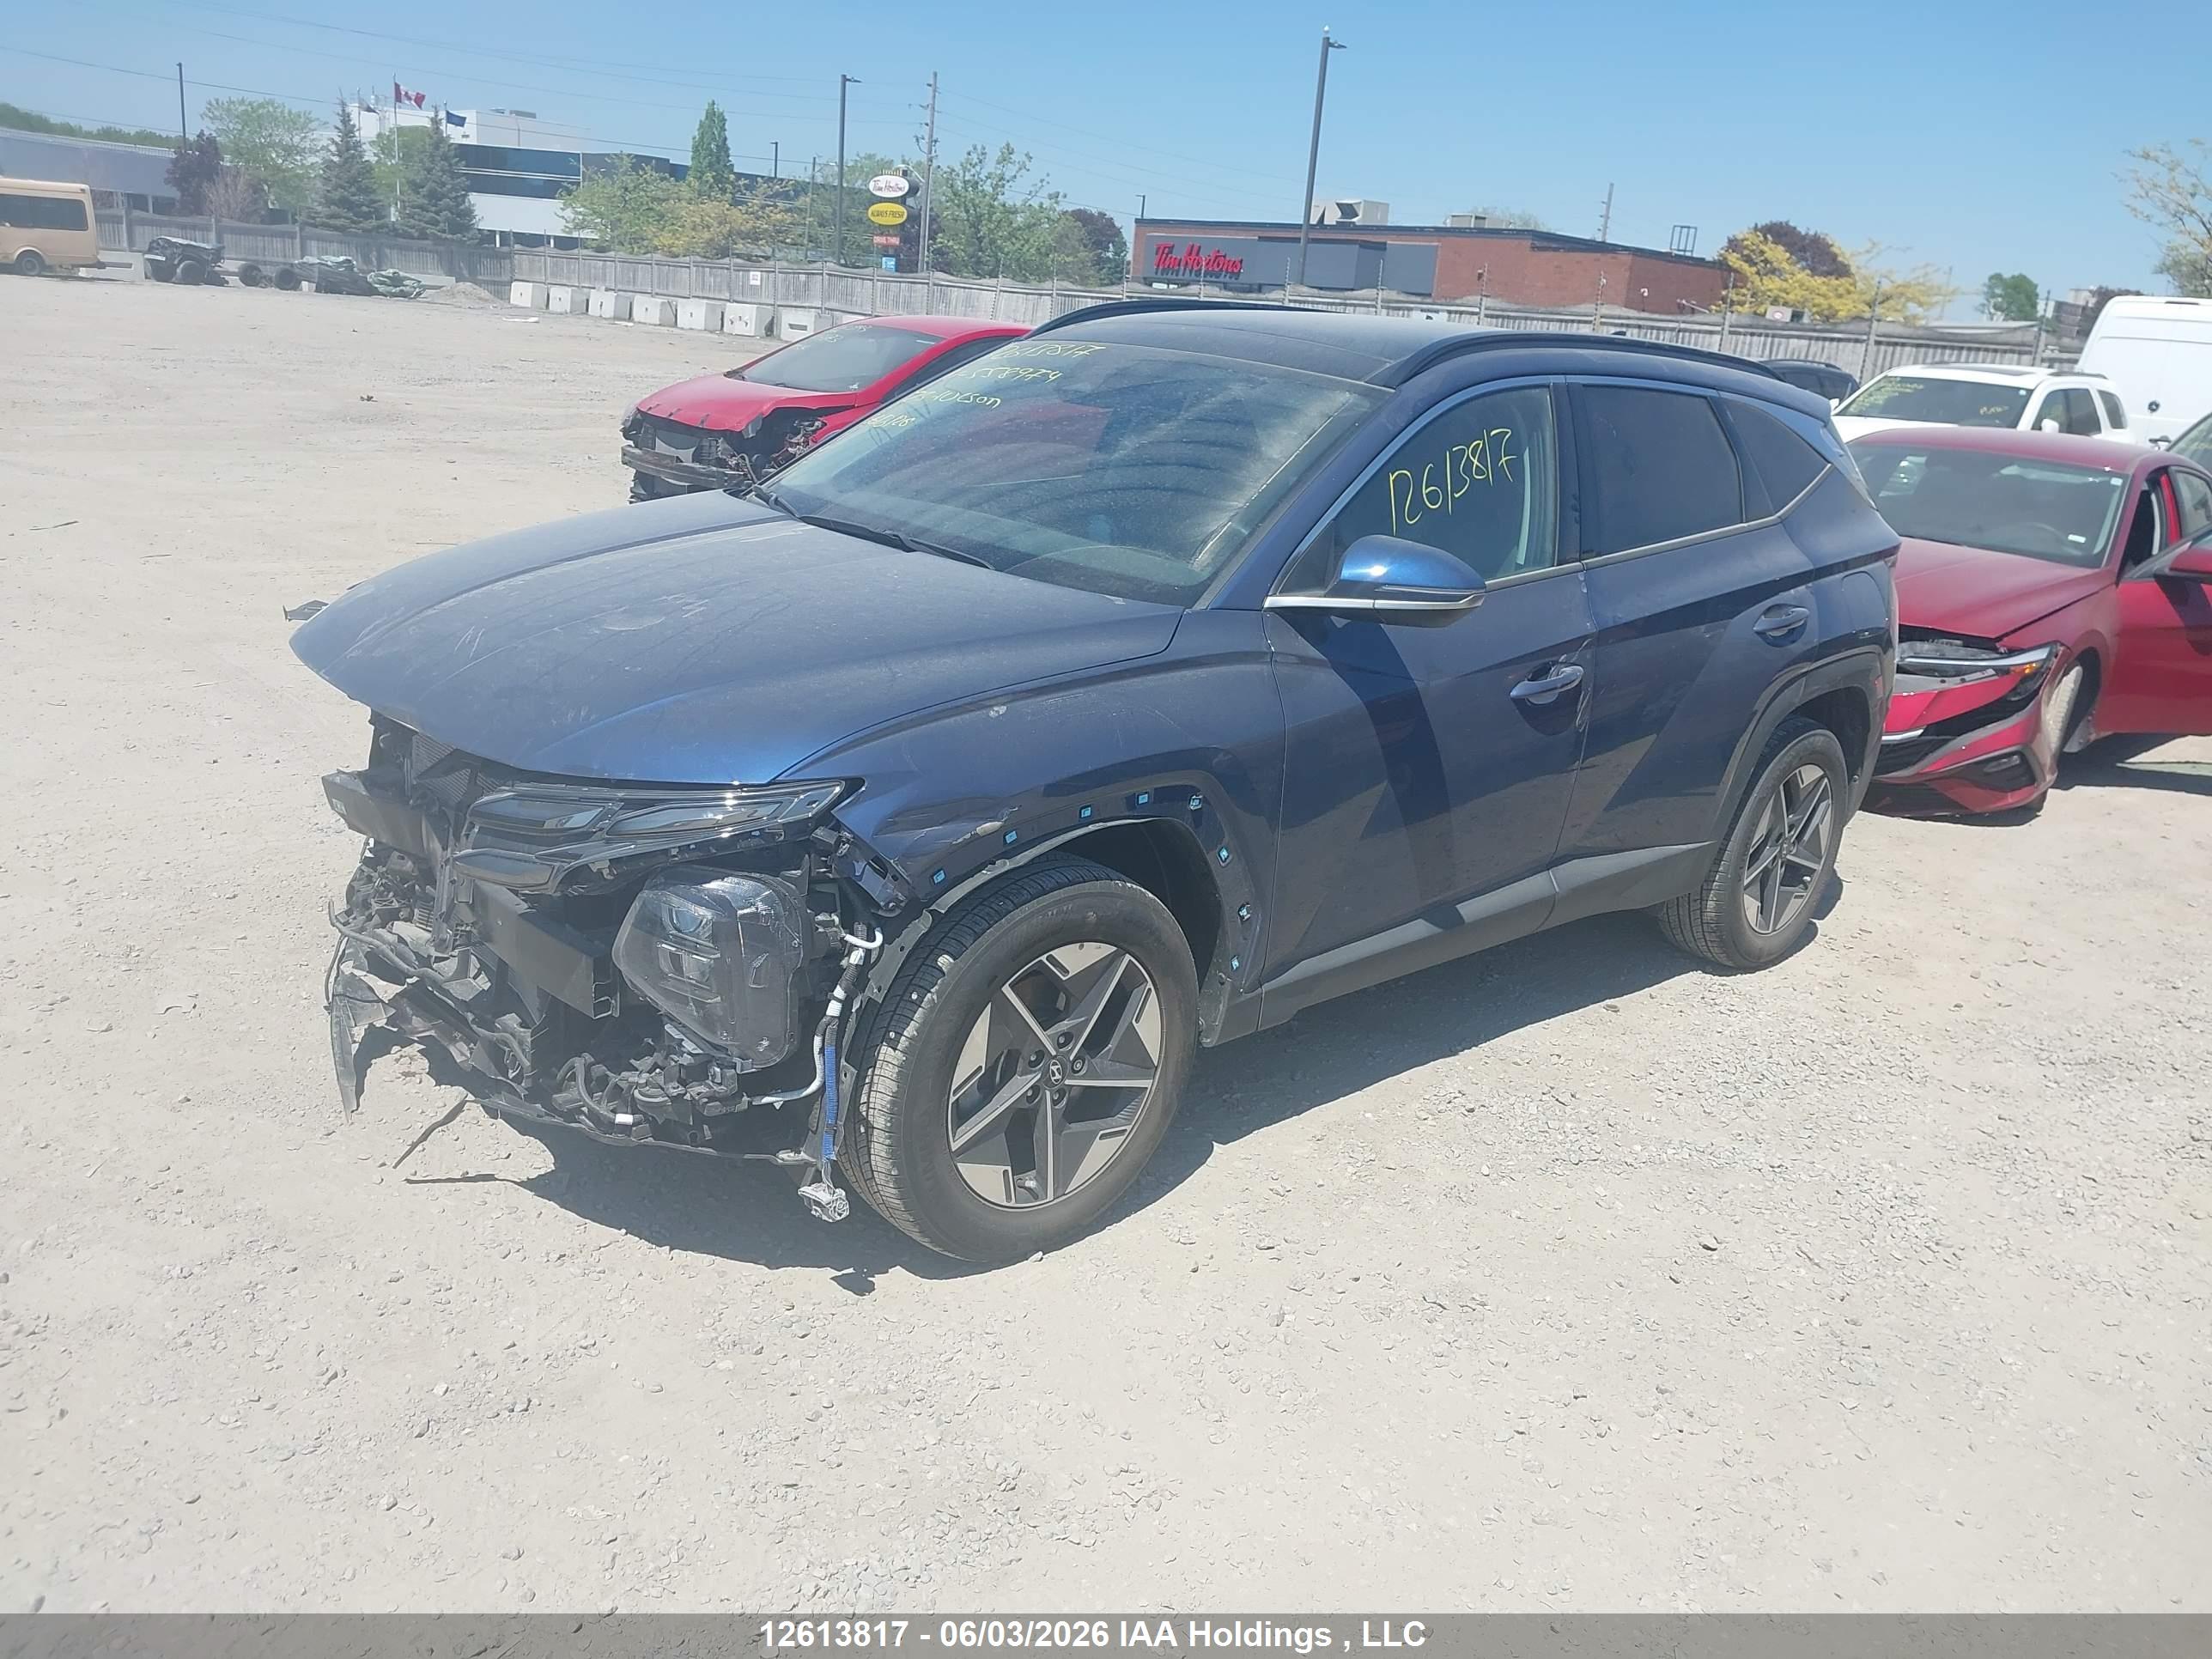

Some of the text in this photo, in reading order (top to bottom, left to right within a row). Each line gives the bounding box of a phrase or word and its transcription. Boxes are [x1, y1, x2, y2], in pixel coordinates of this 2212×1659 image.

[872, 179, 883, 192] Tim
[1154, 242, 1242, 273] Tim Hortons
[1389, 428, 1518, 537] 12613817
